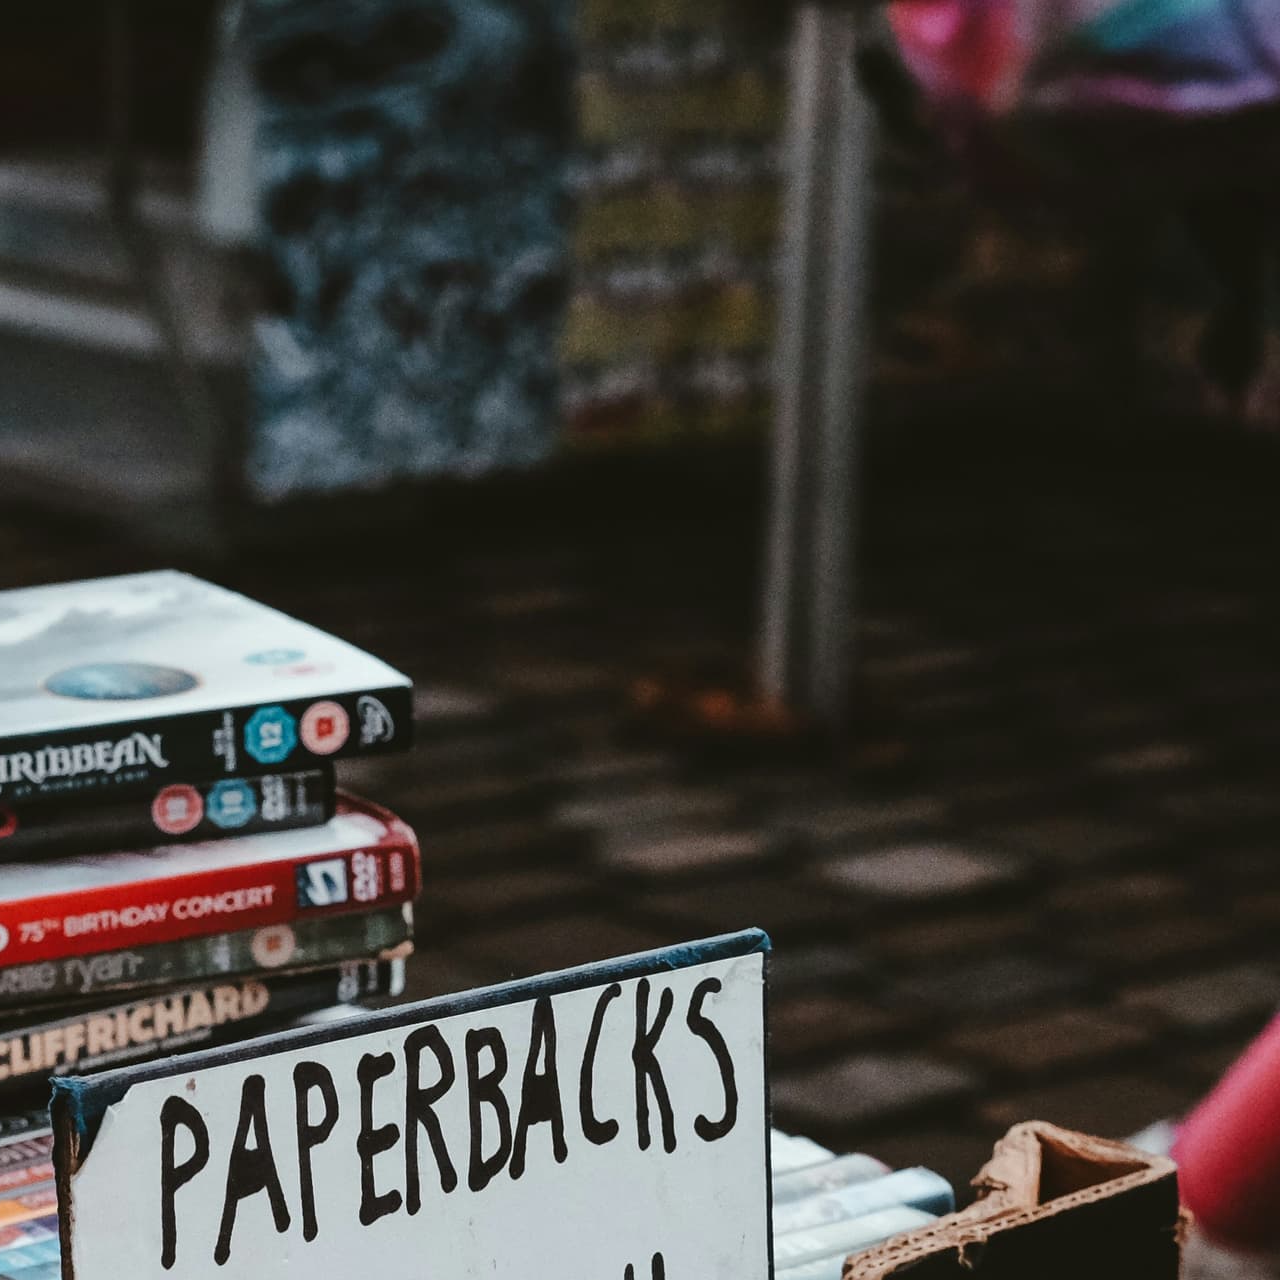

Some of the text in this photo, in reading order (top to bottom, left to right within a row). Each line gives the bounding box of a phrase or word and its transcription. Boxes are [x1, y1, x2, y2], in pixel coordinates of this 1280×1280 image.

[63, 901, 168, 938] BIRTHDAY
[173, 883, 276, 922] CONCERT
[159, 977, 739, 1272] PAPERBACKS
